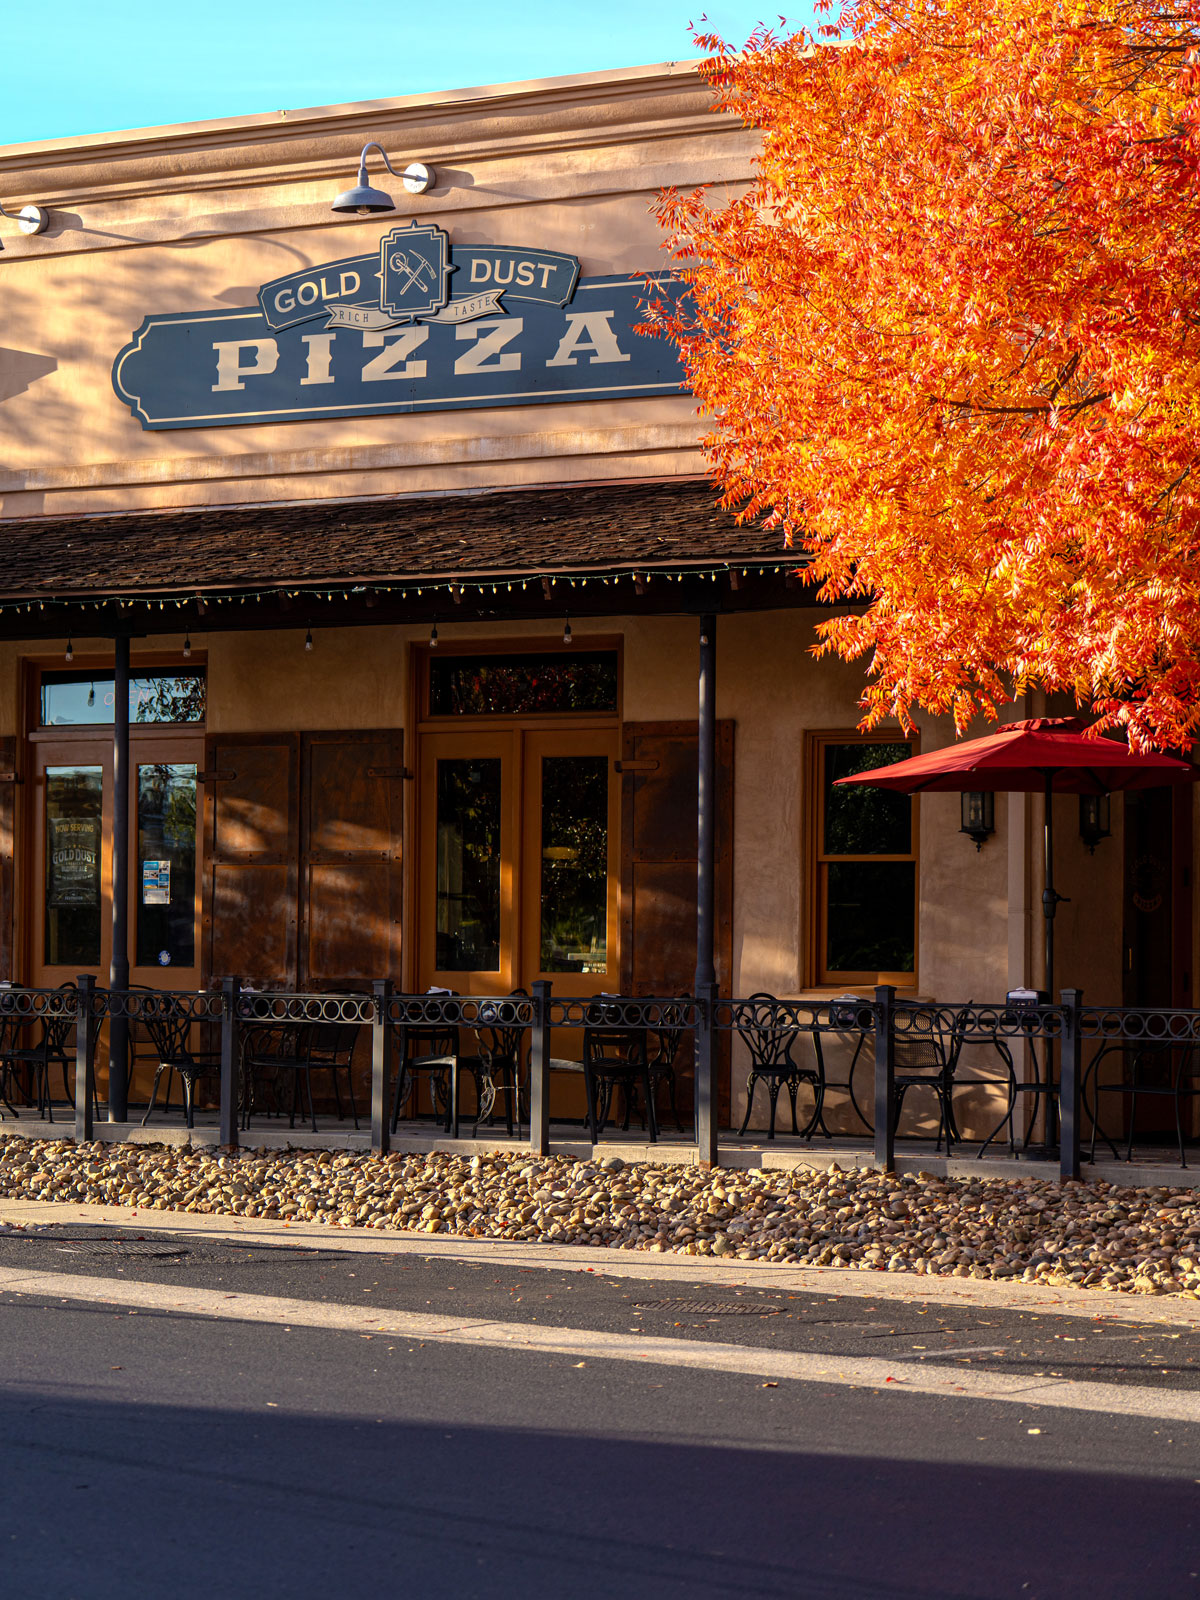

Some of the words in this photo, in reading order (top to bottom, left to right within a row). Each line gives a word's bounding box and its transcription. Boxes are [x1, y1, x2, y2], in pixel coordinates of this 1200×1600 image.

[274, 271, 361, 313] GOLD
[471, 258, 557, 289] DUST
[338, 309, 371, 325] RICH
[453, 296, 492, 317] TASTE
[211, 310, 631, 392] PIZZA
[103, 688, 150, 706] OEN
[55, 824, 69, 833] NOW
[70, 823, 94, 833] SERVING
[52, 849, 75, 865] GOLD
[75, 848, 97, 865] DUST
